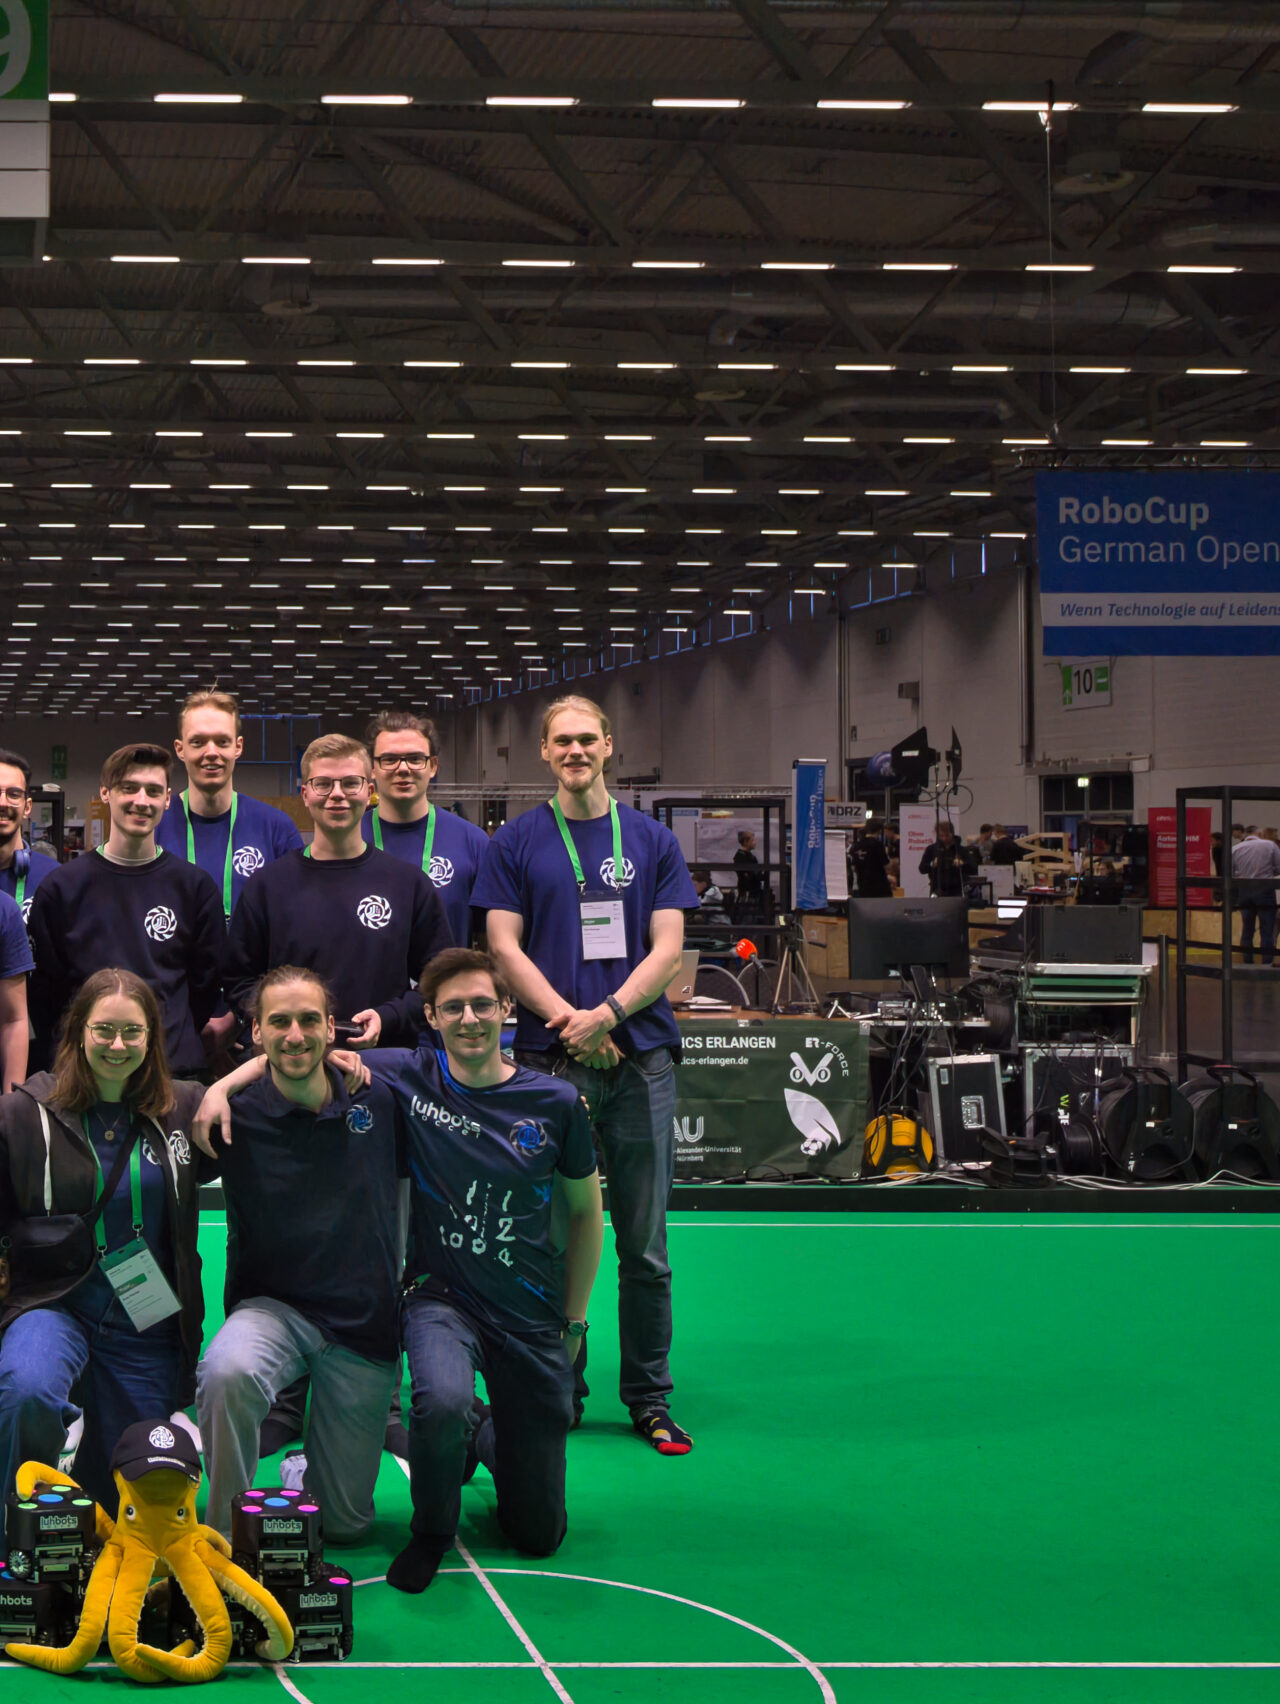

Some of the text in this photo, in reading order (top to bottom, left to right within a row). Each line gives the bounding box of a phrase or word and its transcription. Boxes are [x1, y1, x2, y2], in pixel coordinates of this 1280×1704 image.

[1059, 495, 1210, 531] RoboCup
[1059, 535, 1280, 570] German Open
[1060, 603, 1103, 617] Wenn
[1108, 602, 1195, 620] Technologie
[1200, 602, 1226, 620] auf
[1073, 668, 1094, 695] 10
[835, 806, 862, 816] DRZ
[706, 1036, 776, 1049] ERLANGEN
[681, 1056, 749, 1067] ics-erlangen.de
[805, 1037, 849, 1077] ER-FORCE
[411, 1095, 481, 1132] luhbots
[40, 1515, 78, 1526] luhbots
[264, 1519, 302, 1530] luhbots
[300, 1593, 337, 1605] luhbots
